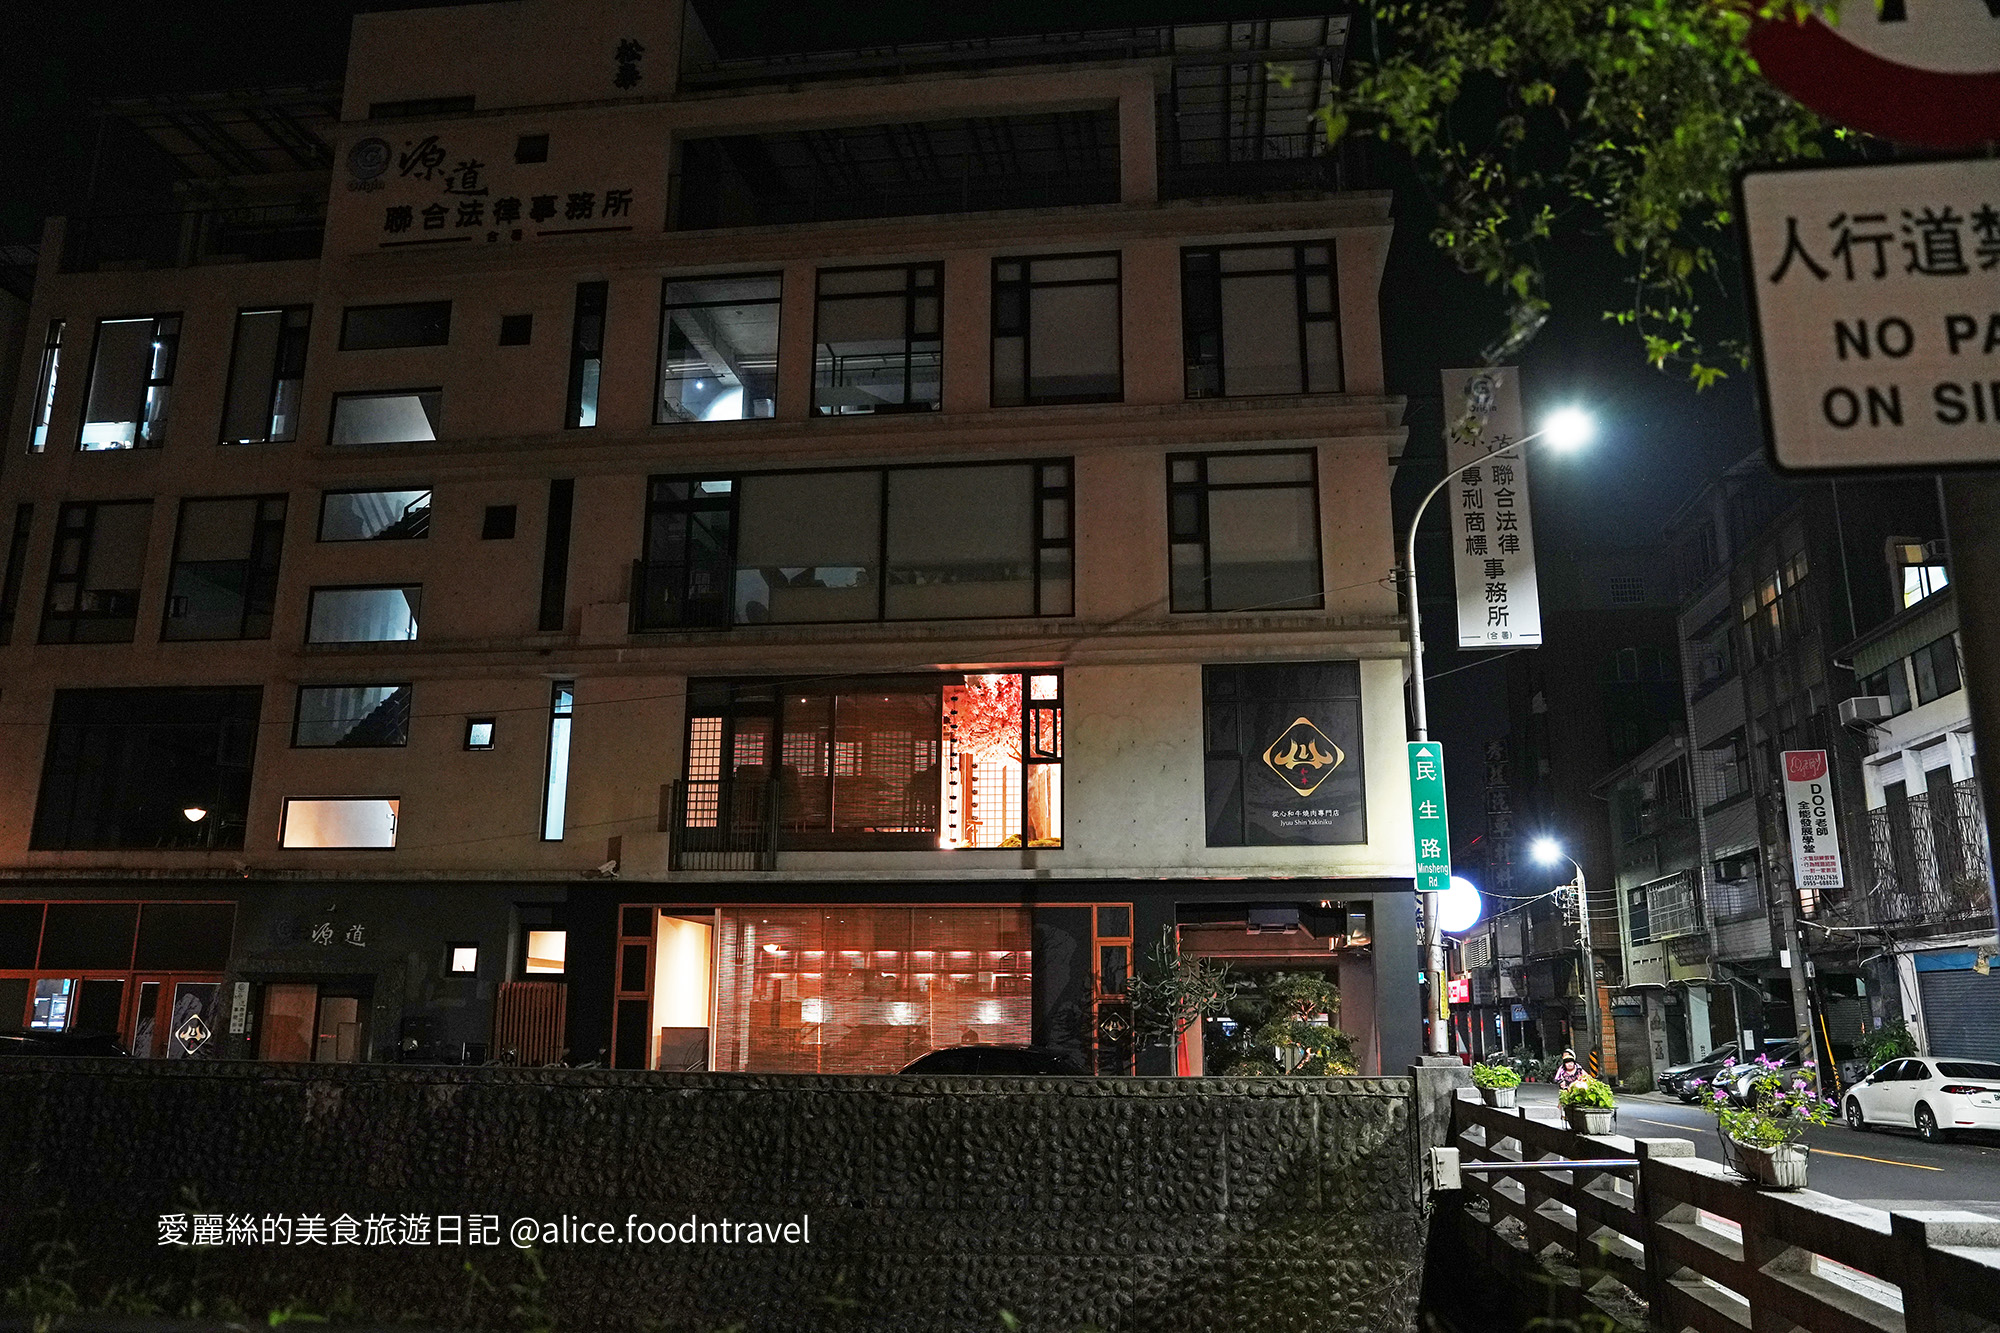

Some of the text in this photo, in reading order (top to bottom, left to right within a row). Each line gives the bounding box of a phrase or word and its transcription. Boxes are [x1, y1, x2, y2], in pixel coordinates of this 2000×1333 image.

[399, 135, 489, 197] 源道
[384, 188, 634, 233] 聯合法律事務所
[1834, 317, 1914, 360] NO
[1822, 385, 1904, 429] ON
[1460, 466, 1488, 556] 專利商標
[1491, 464, 1521, 555] 聯合法律
[1483, 557, 1510, 627] 事務所
[1415, 760, 1442, 859] 民生路
[1417, 862, 1449, 876] Minsheng
[311, 921, 367, 948] 源道
